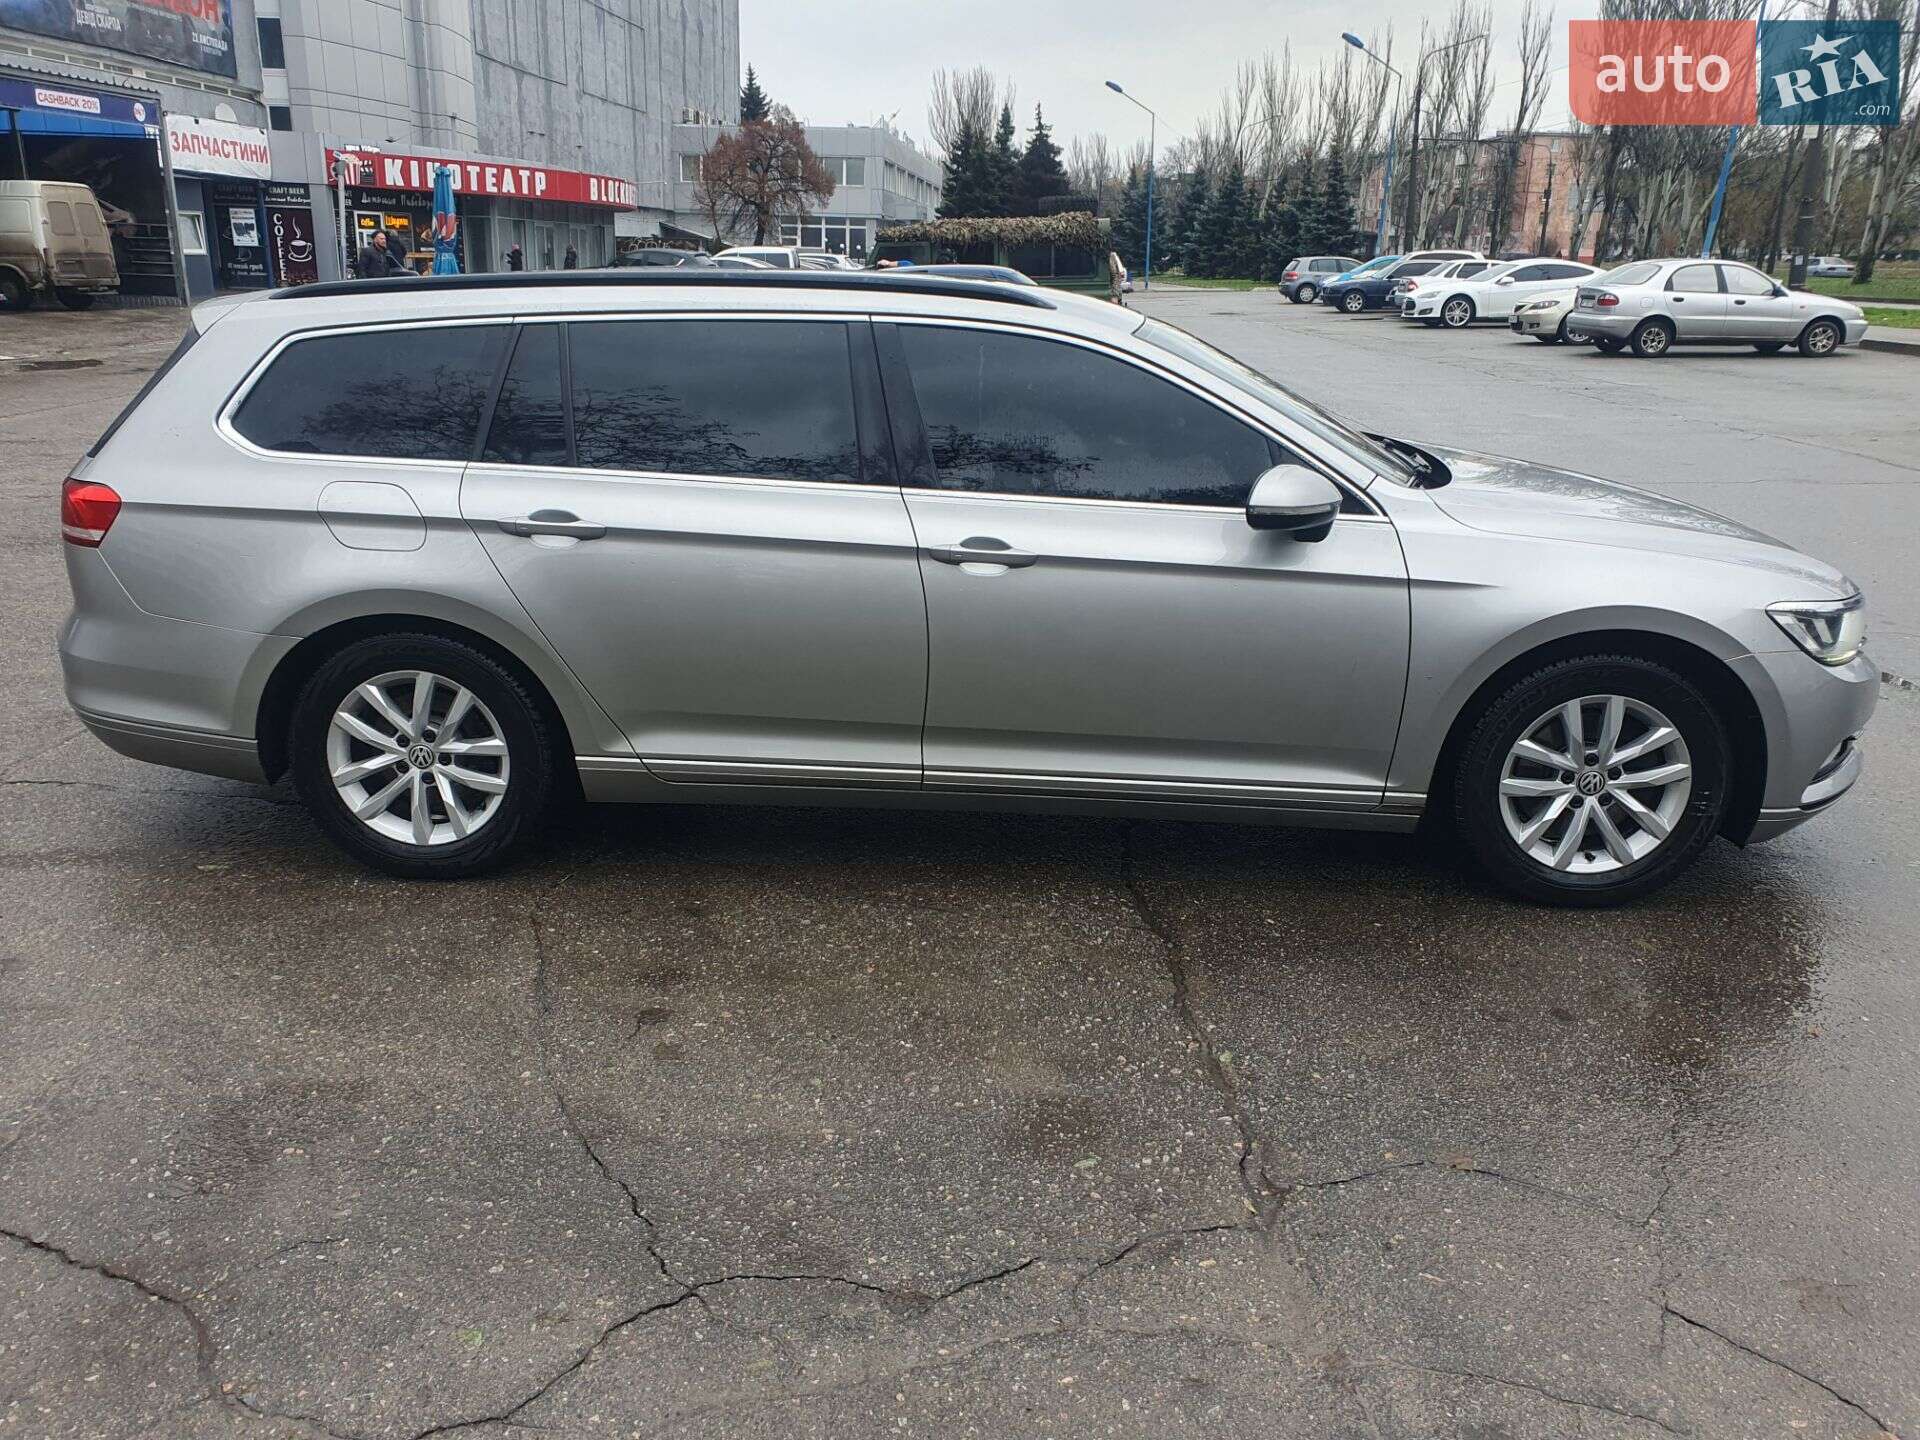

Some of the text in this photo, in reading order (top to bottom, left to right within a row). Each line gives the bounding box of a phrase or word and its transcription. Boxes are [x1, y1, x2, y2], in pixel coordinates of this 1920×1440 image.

[38, 92, 80, 108] CASHBACK
[170, 131, 269, 164] ЗАПЧАСТИНИ
[273, 213, 287, 281] COFFEE
